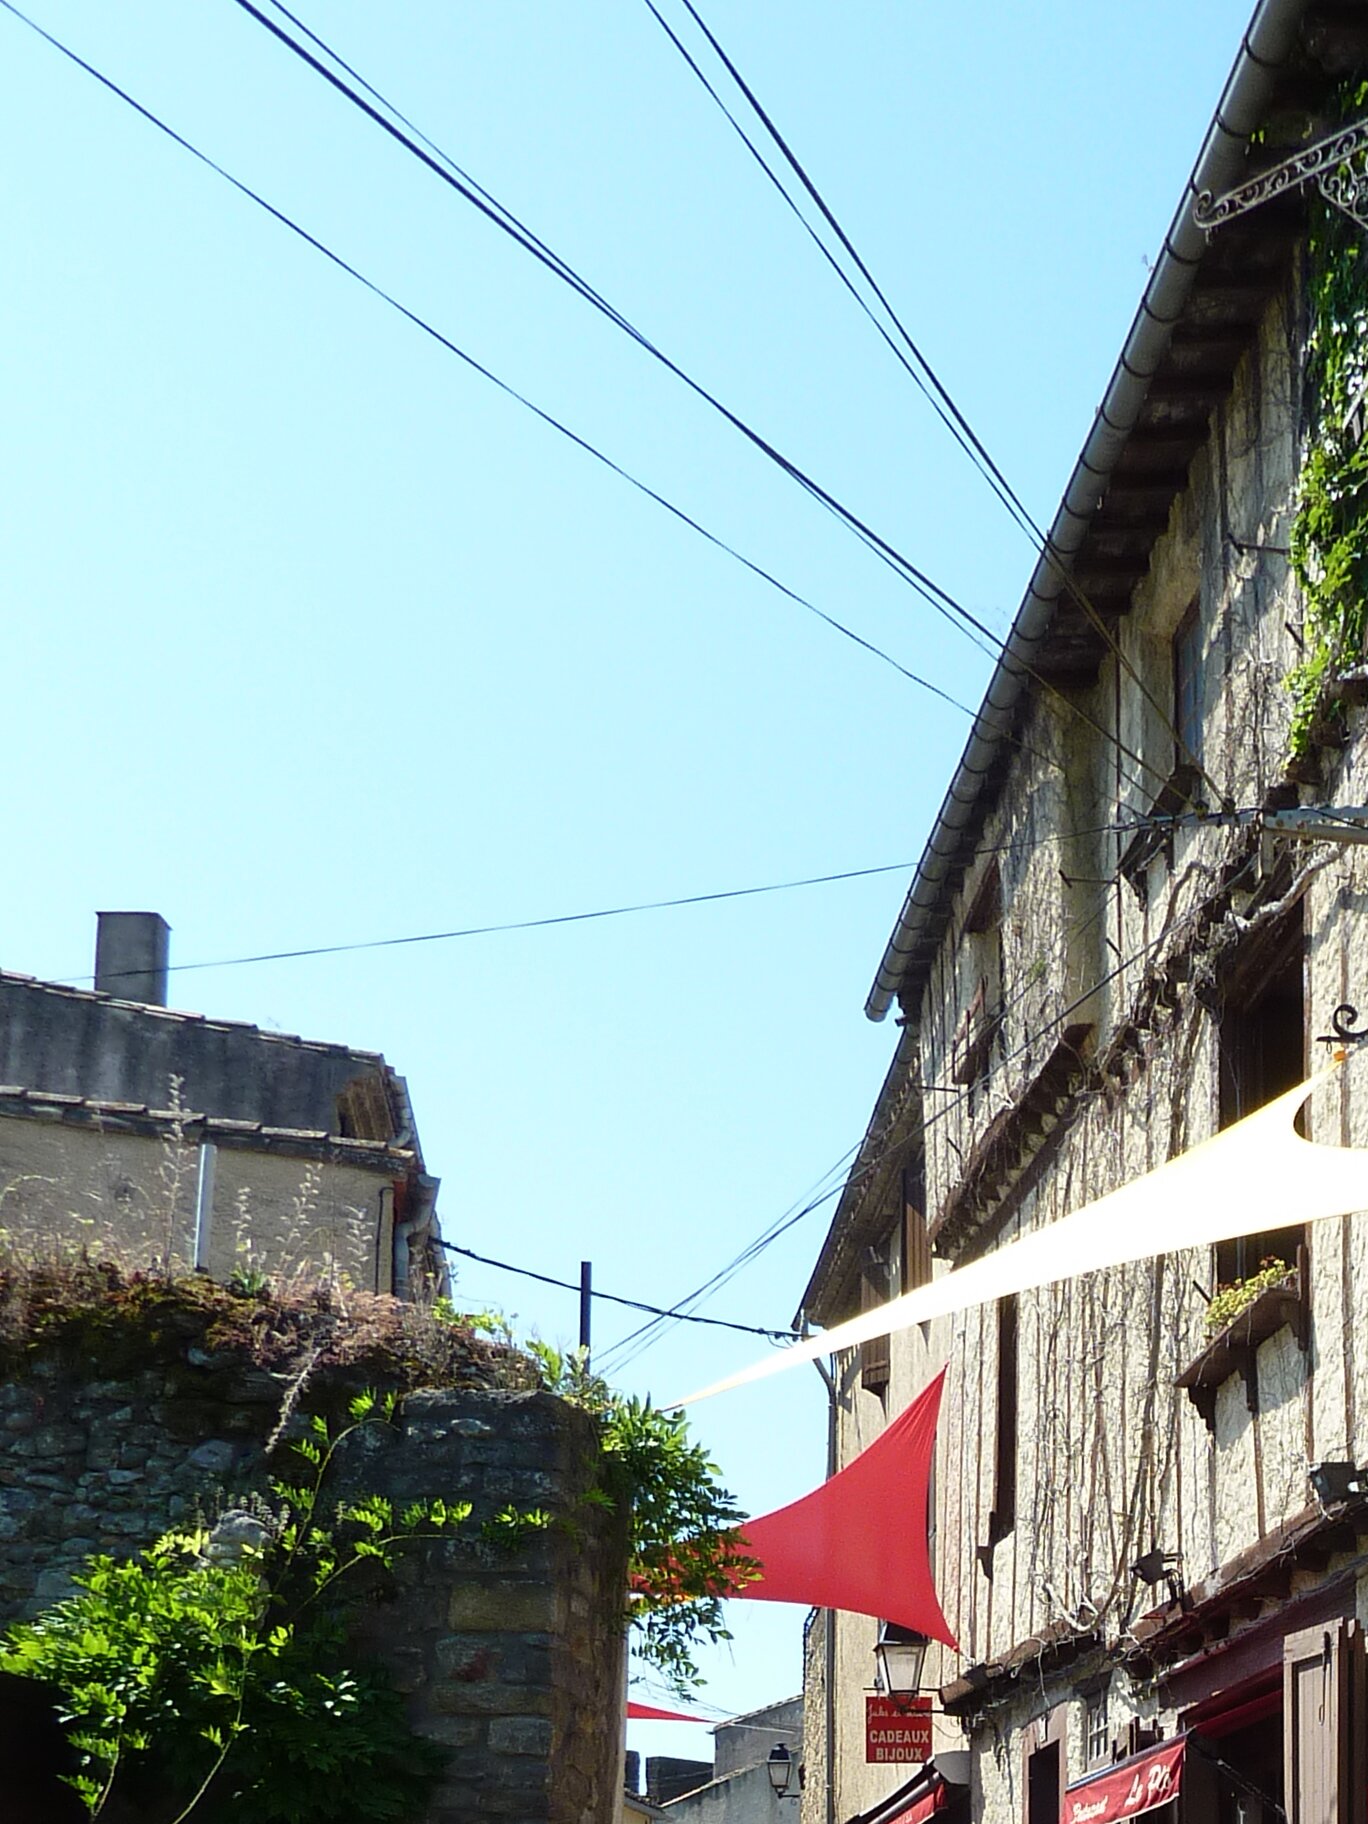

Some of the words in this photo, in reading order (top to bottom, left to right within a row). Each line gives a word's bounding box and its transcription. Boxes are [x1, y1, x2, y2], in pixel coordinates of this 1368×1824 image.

[869, 1730, 929, 1744] CADEAUX
[876, 1747, 923, 1761] BIJOUX
[1124, 1773, 1144, 1808] Le
